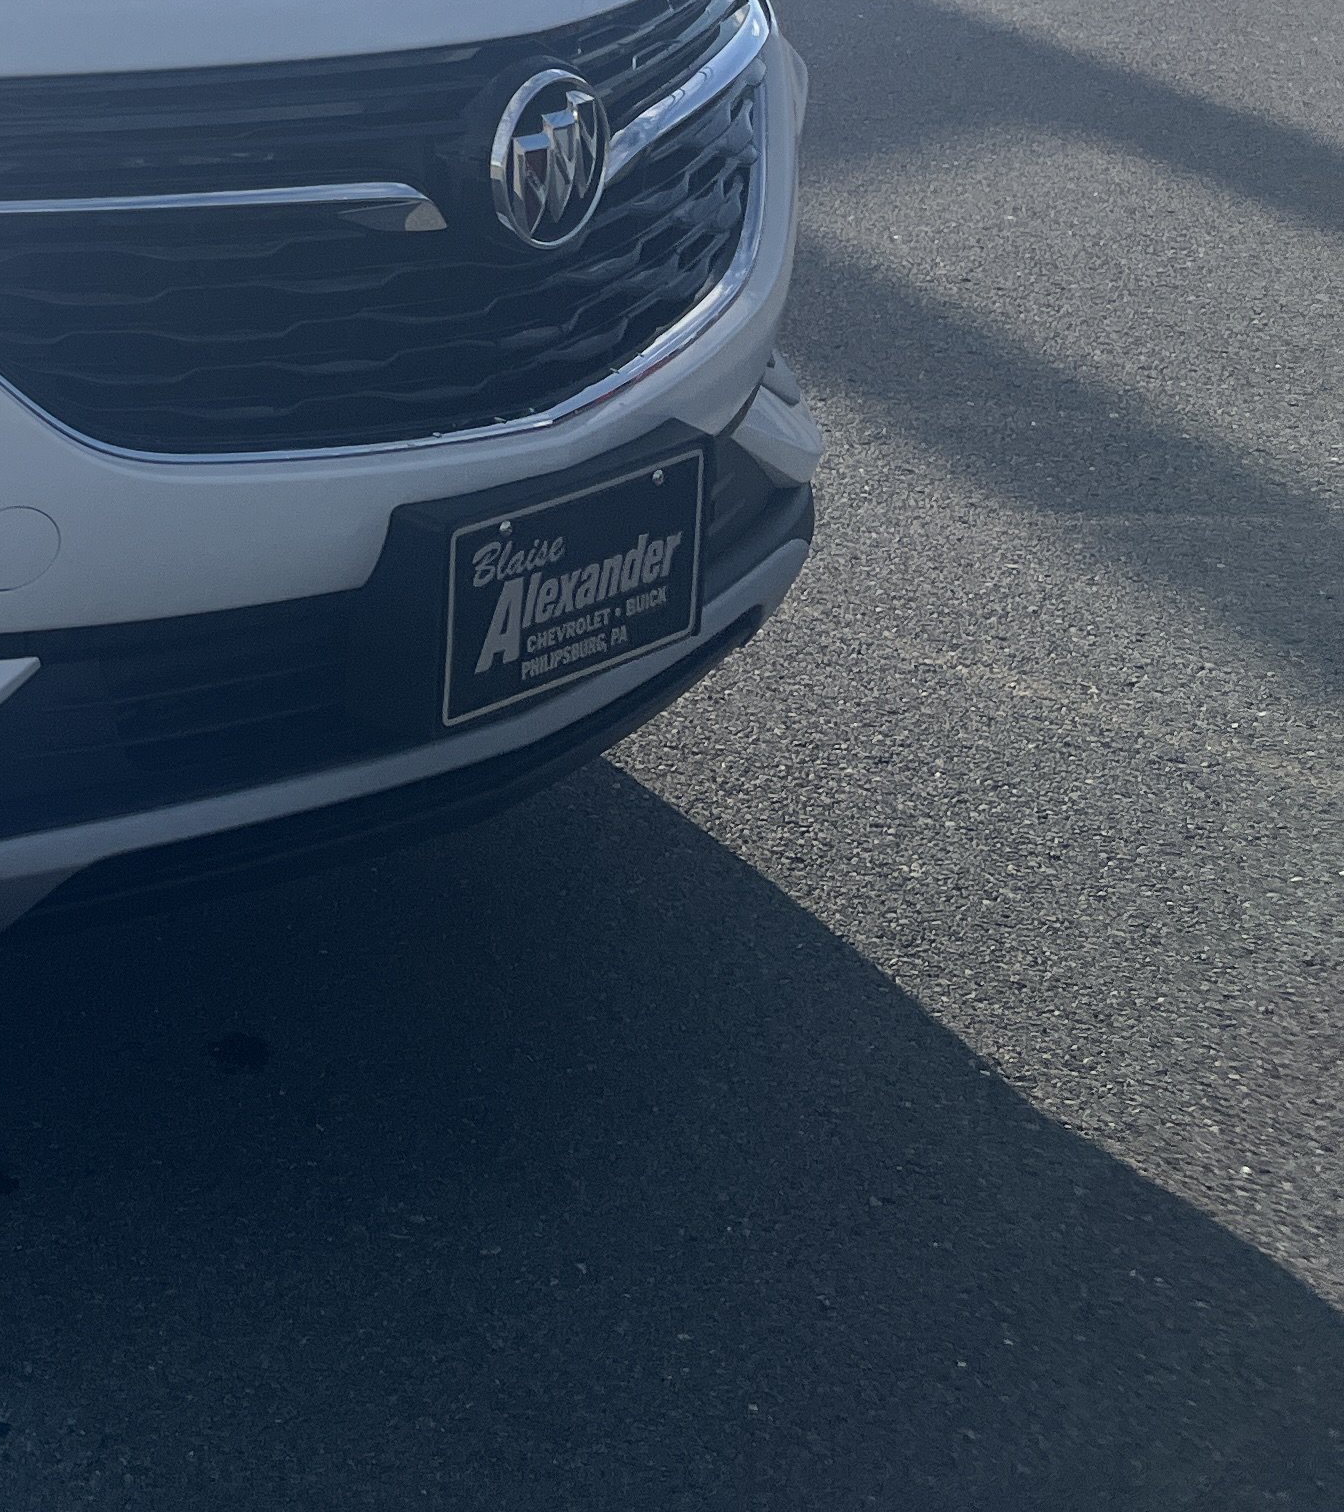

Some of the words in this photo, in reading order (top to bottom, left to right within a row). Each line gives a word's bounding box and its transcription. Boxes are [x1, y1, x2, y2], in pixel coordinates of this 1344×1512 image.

[472, 536, 567, 588] Blaise
[475, 531, 683, 675] Alexander
[527, 607, 611, 653] CHEVROLET
[625, 586, 668, 617] BUICK
[610, 625, 628, 646] PA
